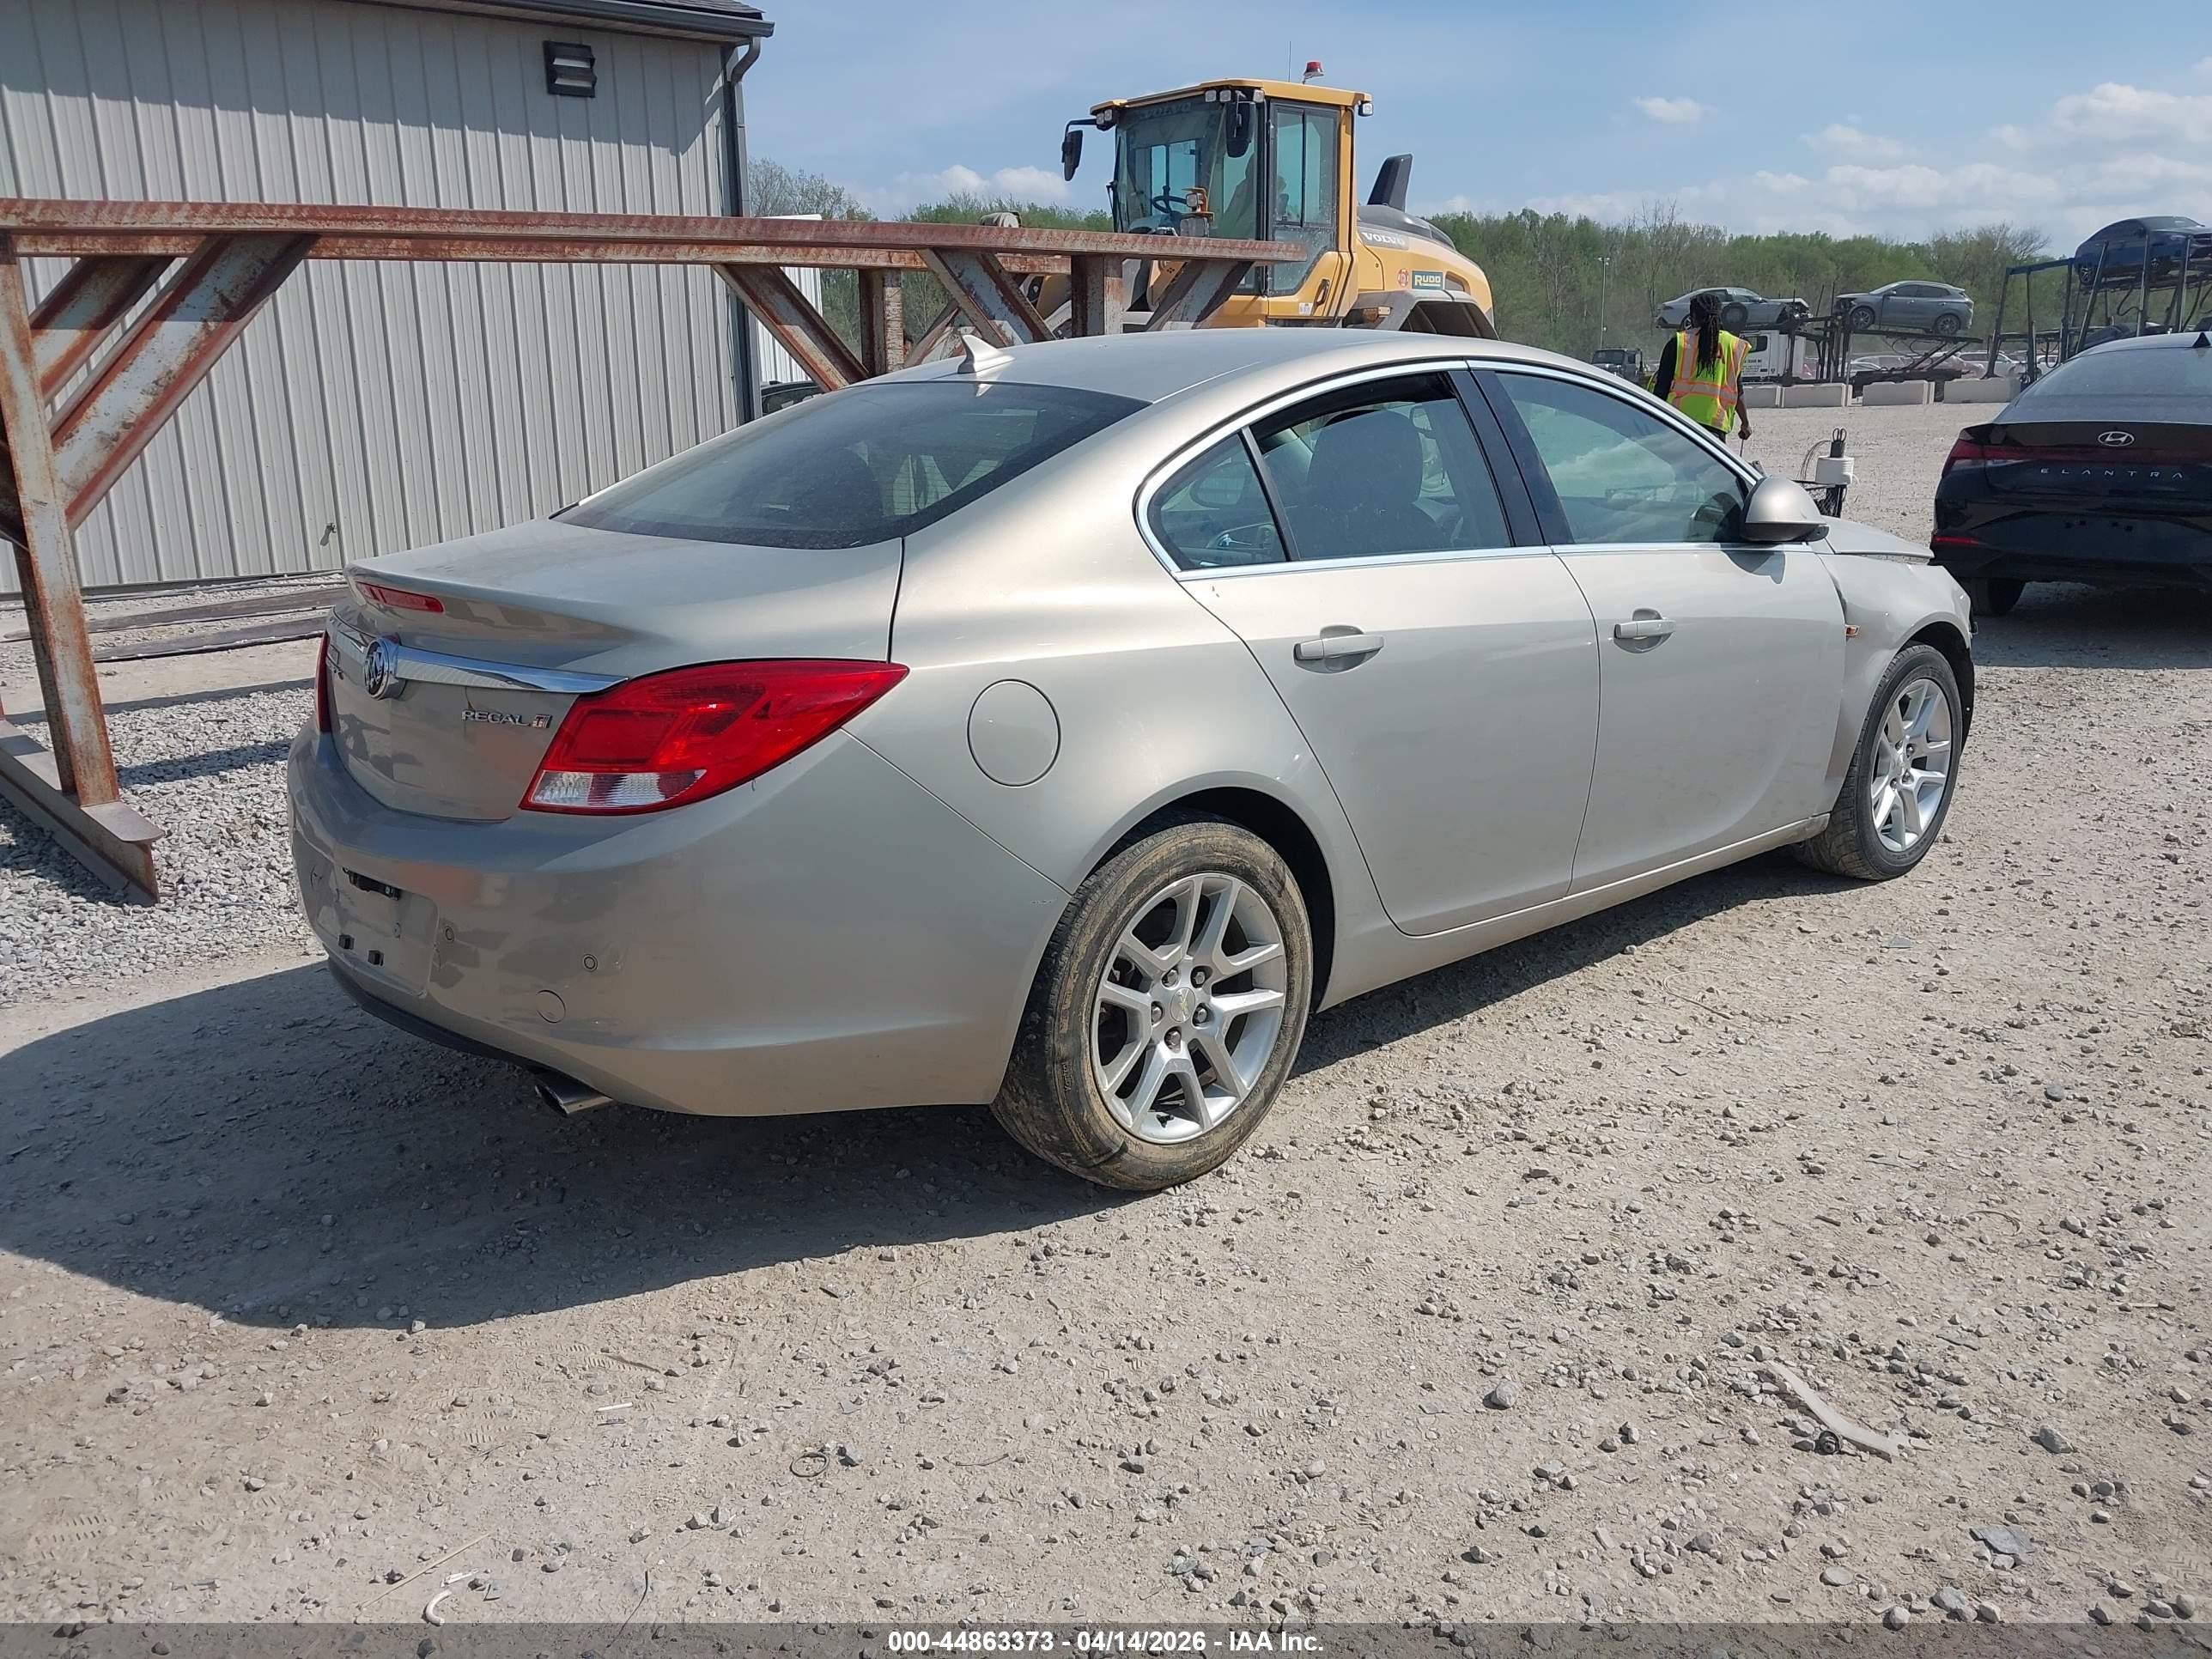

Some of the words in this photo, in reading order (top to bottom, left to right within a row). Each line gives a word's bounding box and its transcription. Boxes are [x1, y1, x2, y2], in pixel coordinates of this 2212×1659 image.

[1361, 231, 1407, 246] VOLVO
[1414, 274, 1442, 287] RUDD
[2040, 468, 2183, 478] ELANTRA
[461, 709, 531, 727] REGAL
